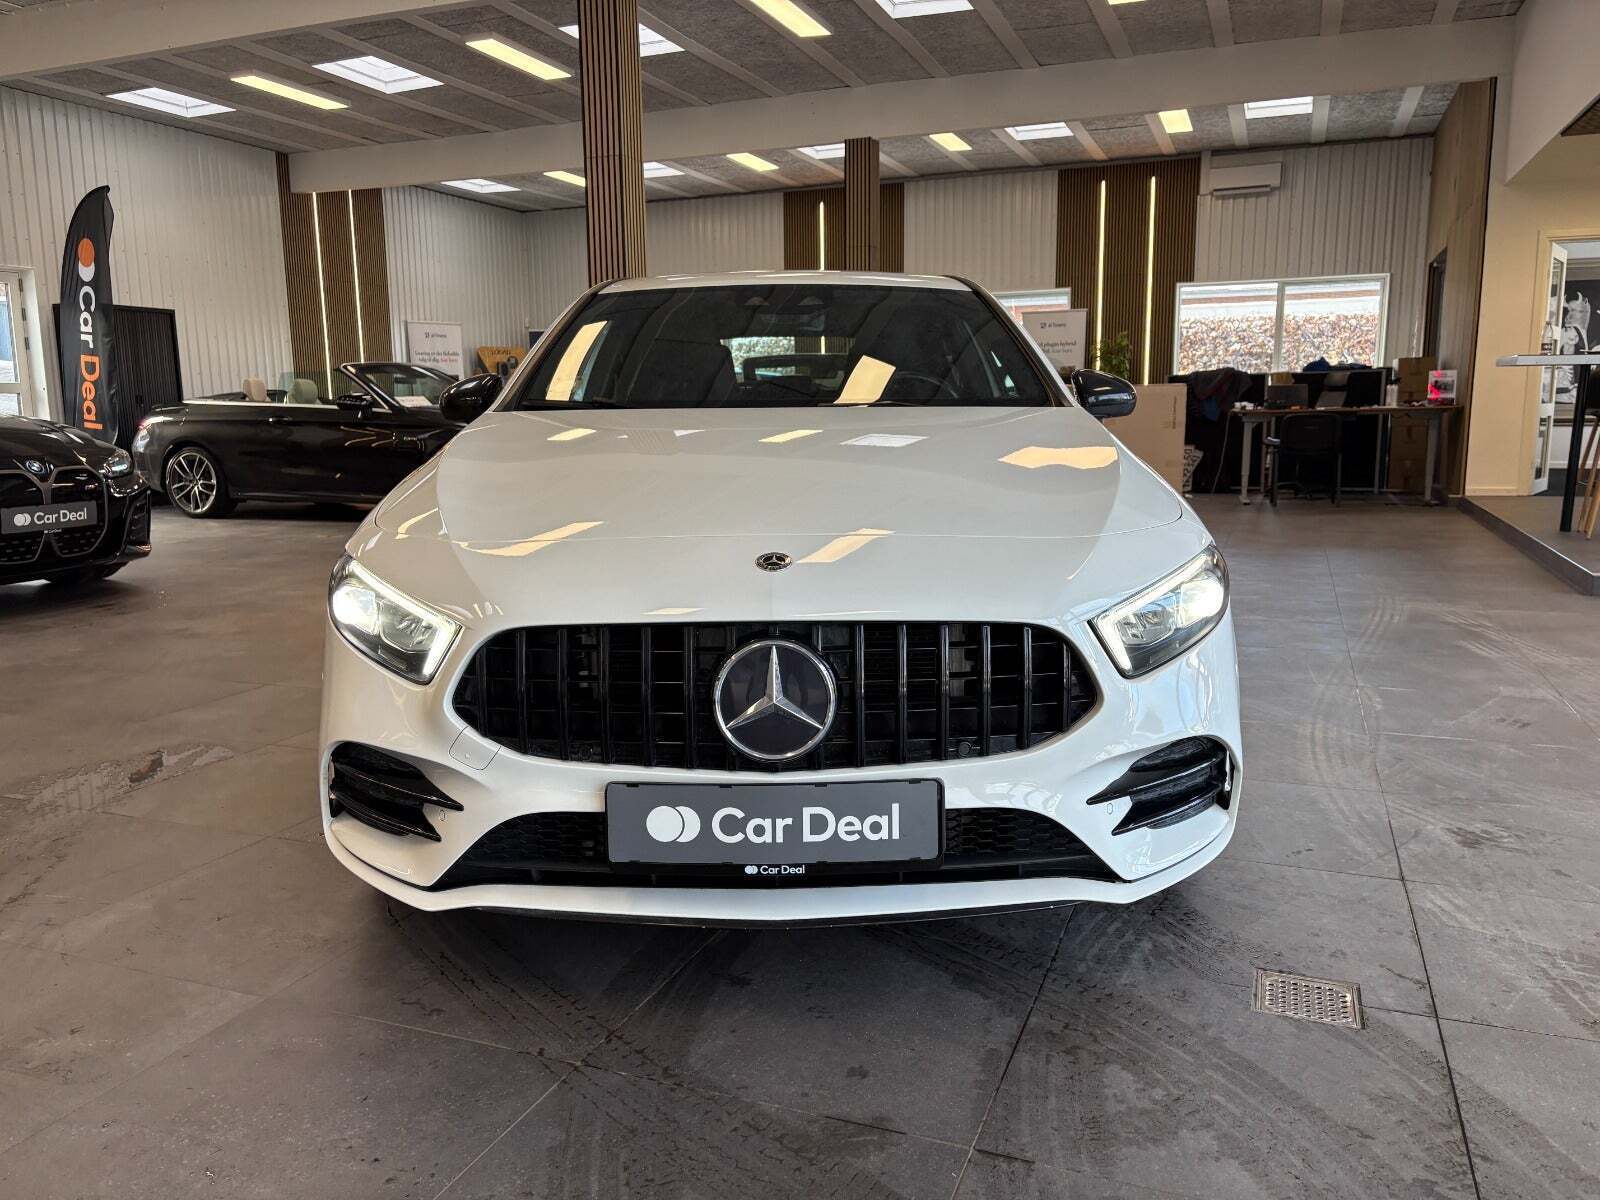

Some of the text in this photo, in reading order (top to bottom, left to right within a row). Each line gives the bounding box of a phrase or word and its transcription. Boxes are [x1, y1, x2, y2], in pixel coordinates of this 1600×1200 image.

[79, 285, 103, 430] Car Deal
[33, 507, 87, 525] Car Deal
[711, 803, 900, 844] Car Deal
[760, 864, 805, 875] Car Deal
